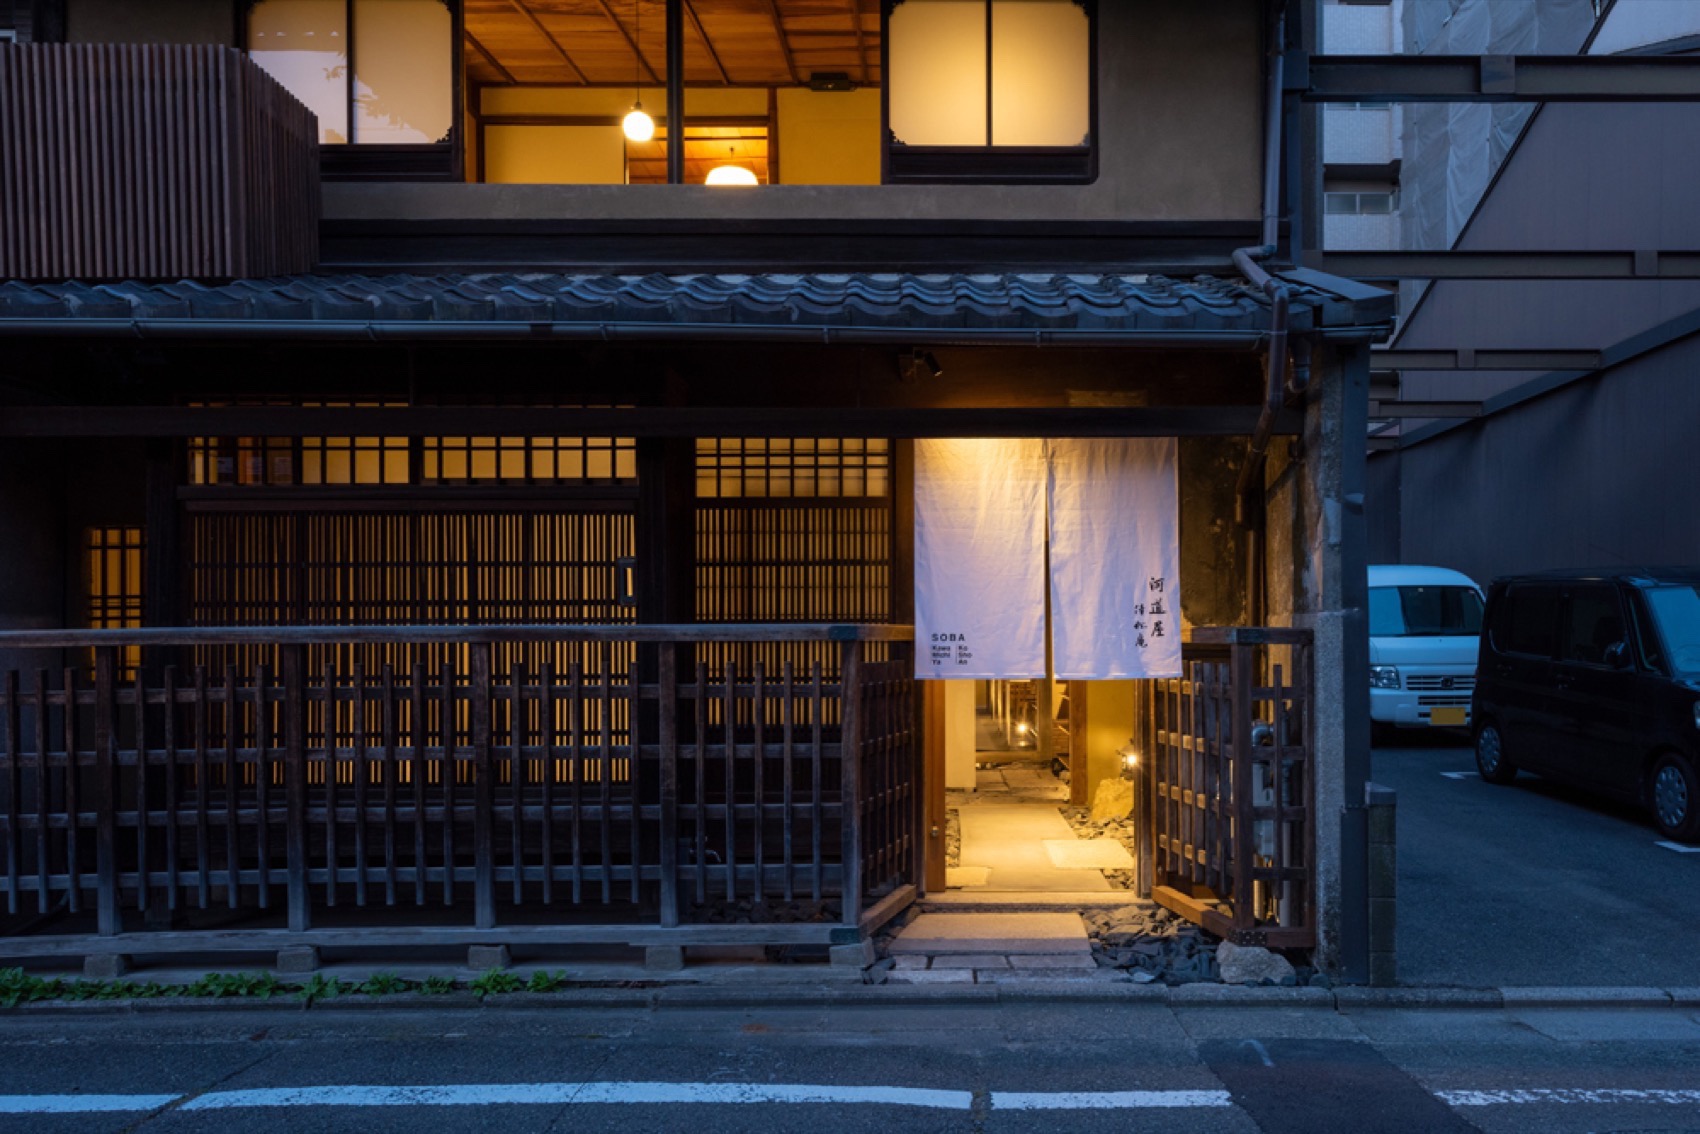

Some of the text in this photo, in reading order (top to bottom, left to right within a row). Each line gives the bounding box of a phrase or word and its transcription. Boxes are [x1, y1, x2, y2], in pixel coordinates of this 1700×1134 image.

[1149, 576, 1166, 638] 河道屋
[931, 633, 966, 642] SOBA
